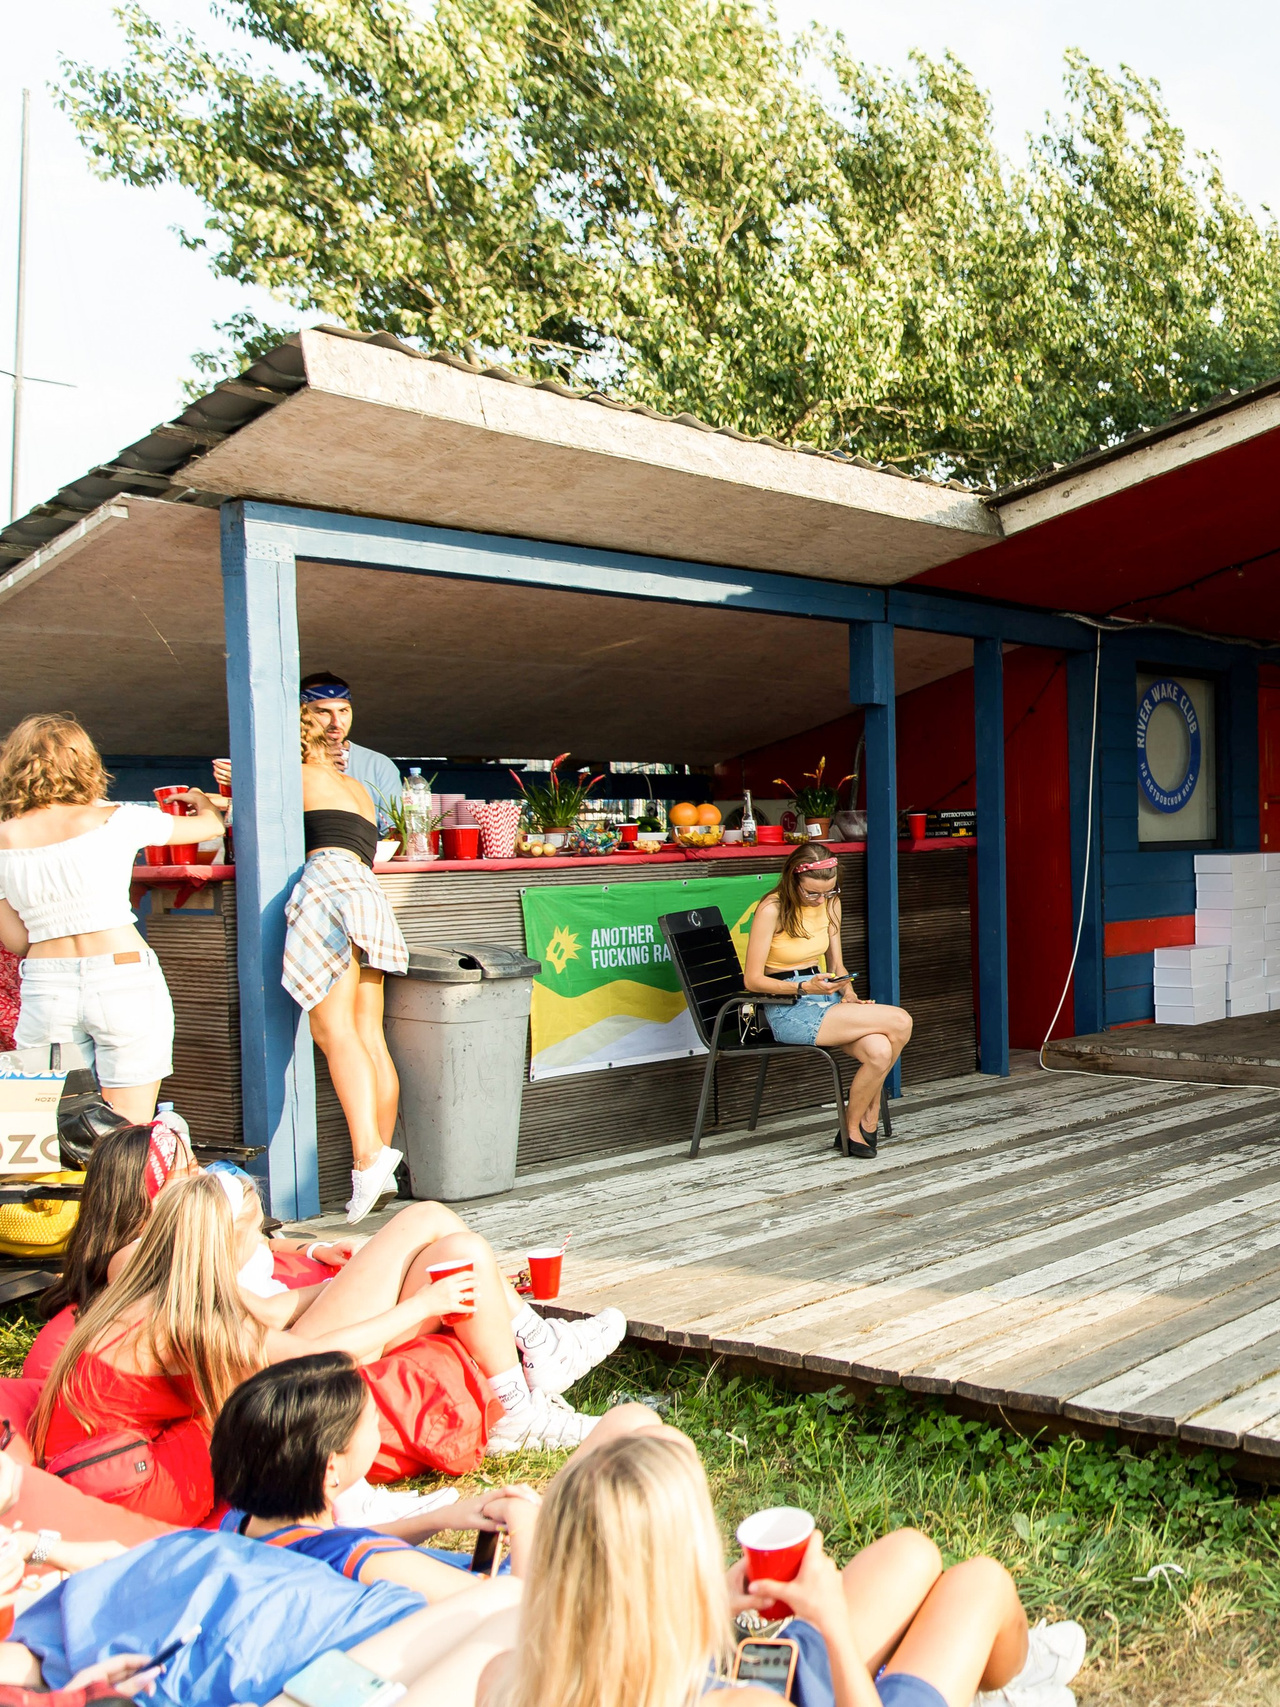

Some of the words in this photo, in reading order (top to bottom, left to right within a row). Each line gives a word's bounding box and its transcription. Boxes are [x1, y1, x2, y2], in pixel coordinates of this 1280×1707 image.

[1136, 698, 1153, 749] RIVER
[1151, 682, 1179, 703] WAKE
[1179, 695, 1198, 735] CLUB
[1140, 762, 1148, 777] на
[1145, 777, 1182, 806] петровской
[1181, 773, 1195, 798] косе
[591, 924, 654, 948] ANOTHER
[591, 945, 650, 969] FUCKING
[653, 943, 672, 963] RA
